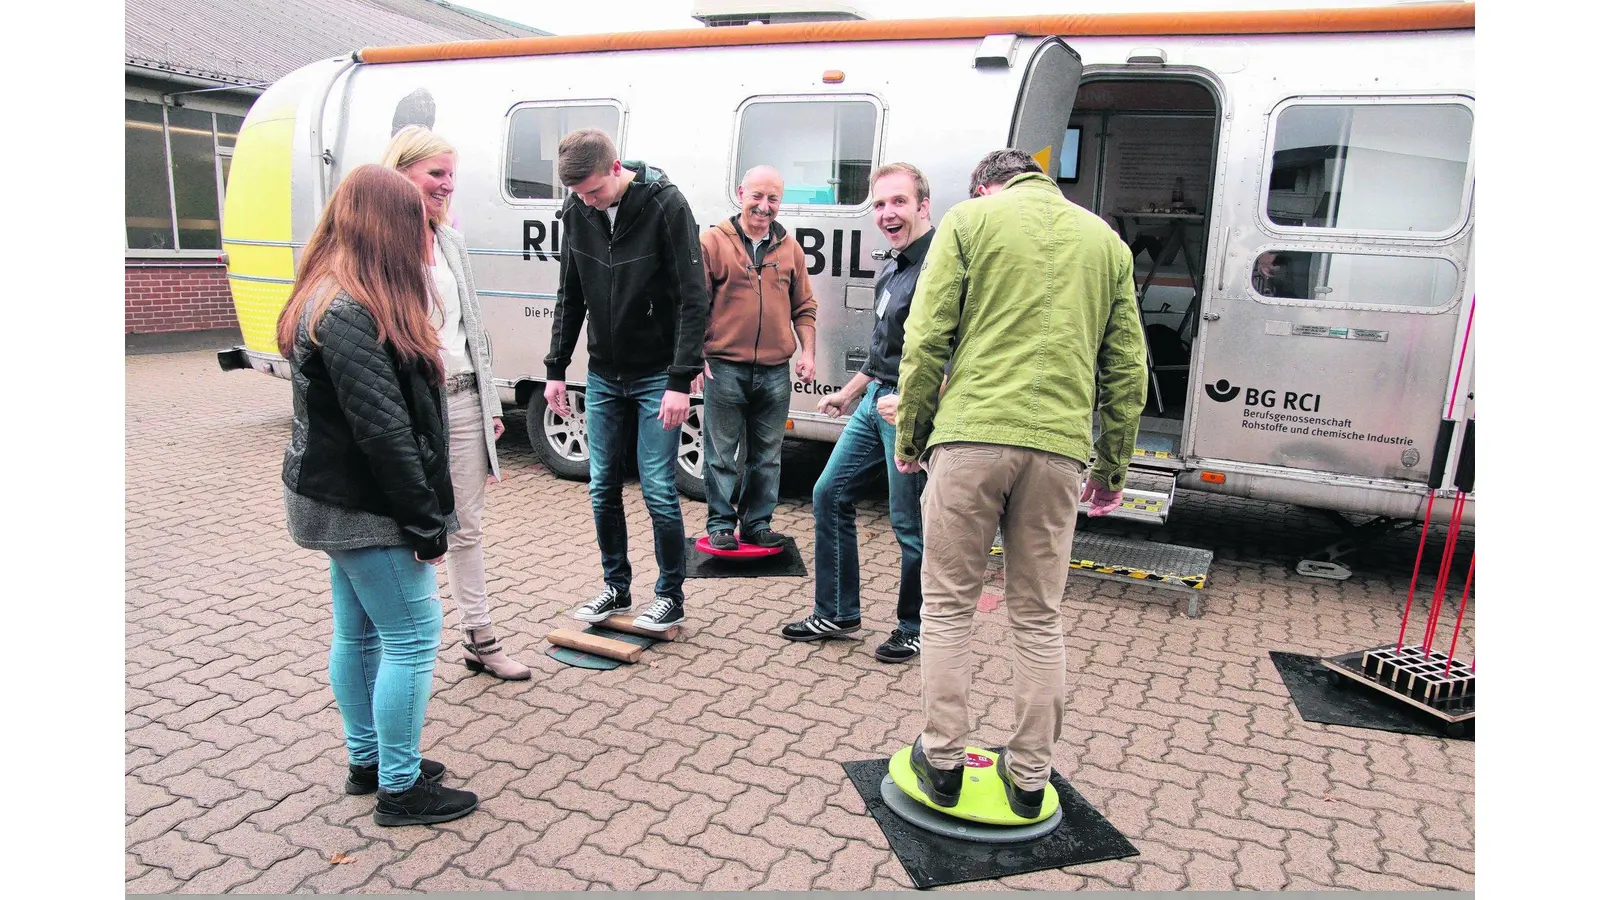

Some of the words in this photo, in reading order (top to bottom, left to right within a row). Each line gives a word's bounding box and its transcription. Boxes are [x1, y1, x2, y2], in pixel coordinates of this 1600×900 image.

[525, 306, 541, 318] Die
[1245, 388, 1276, 408] BG
[1283, 391, 1321, 412] RCI
[1243, 408, 1352, 428] Berufsgenossenschaft
[1241, 420, 1288, 433] Rohstoffe
[1290, 427, 1309, 435] und
[1311, 428, 1365, 441] chemische
[1367, 433, 1414, 446] Industrie
